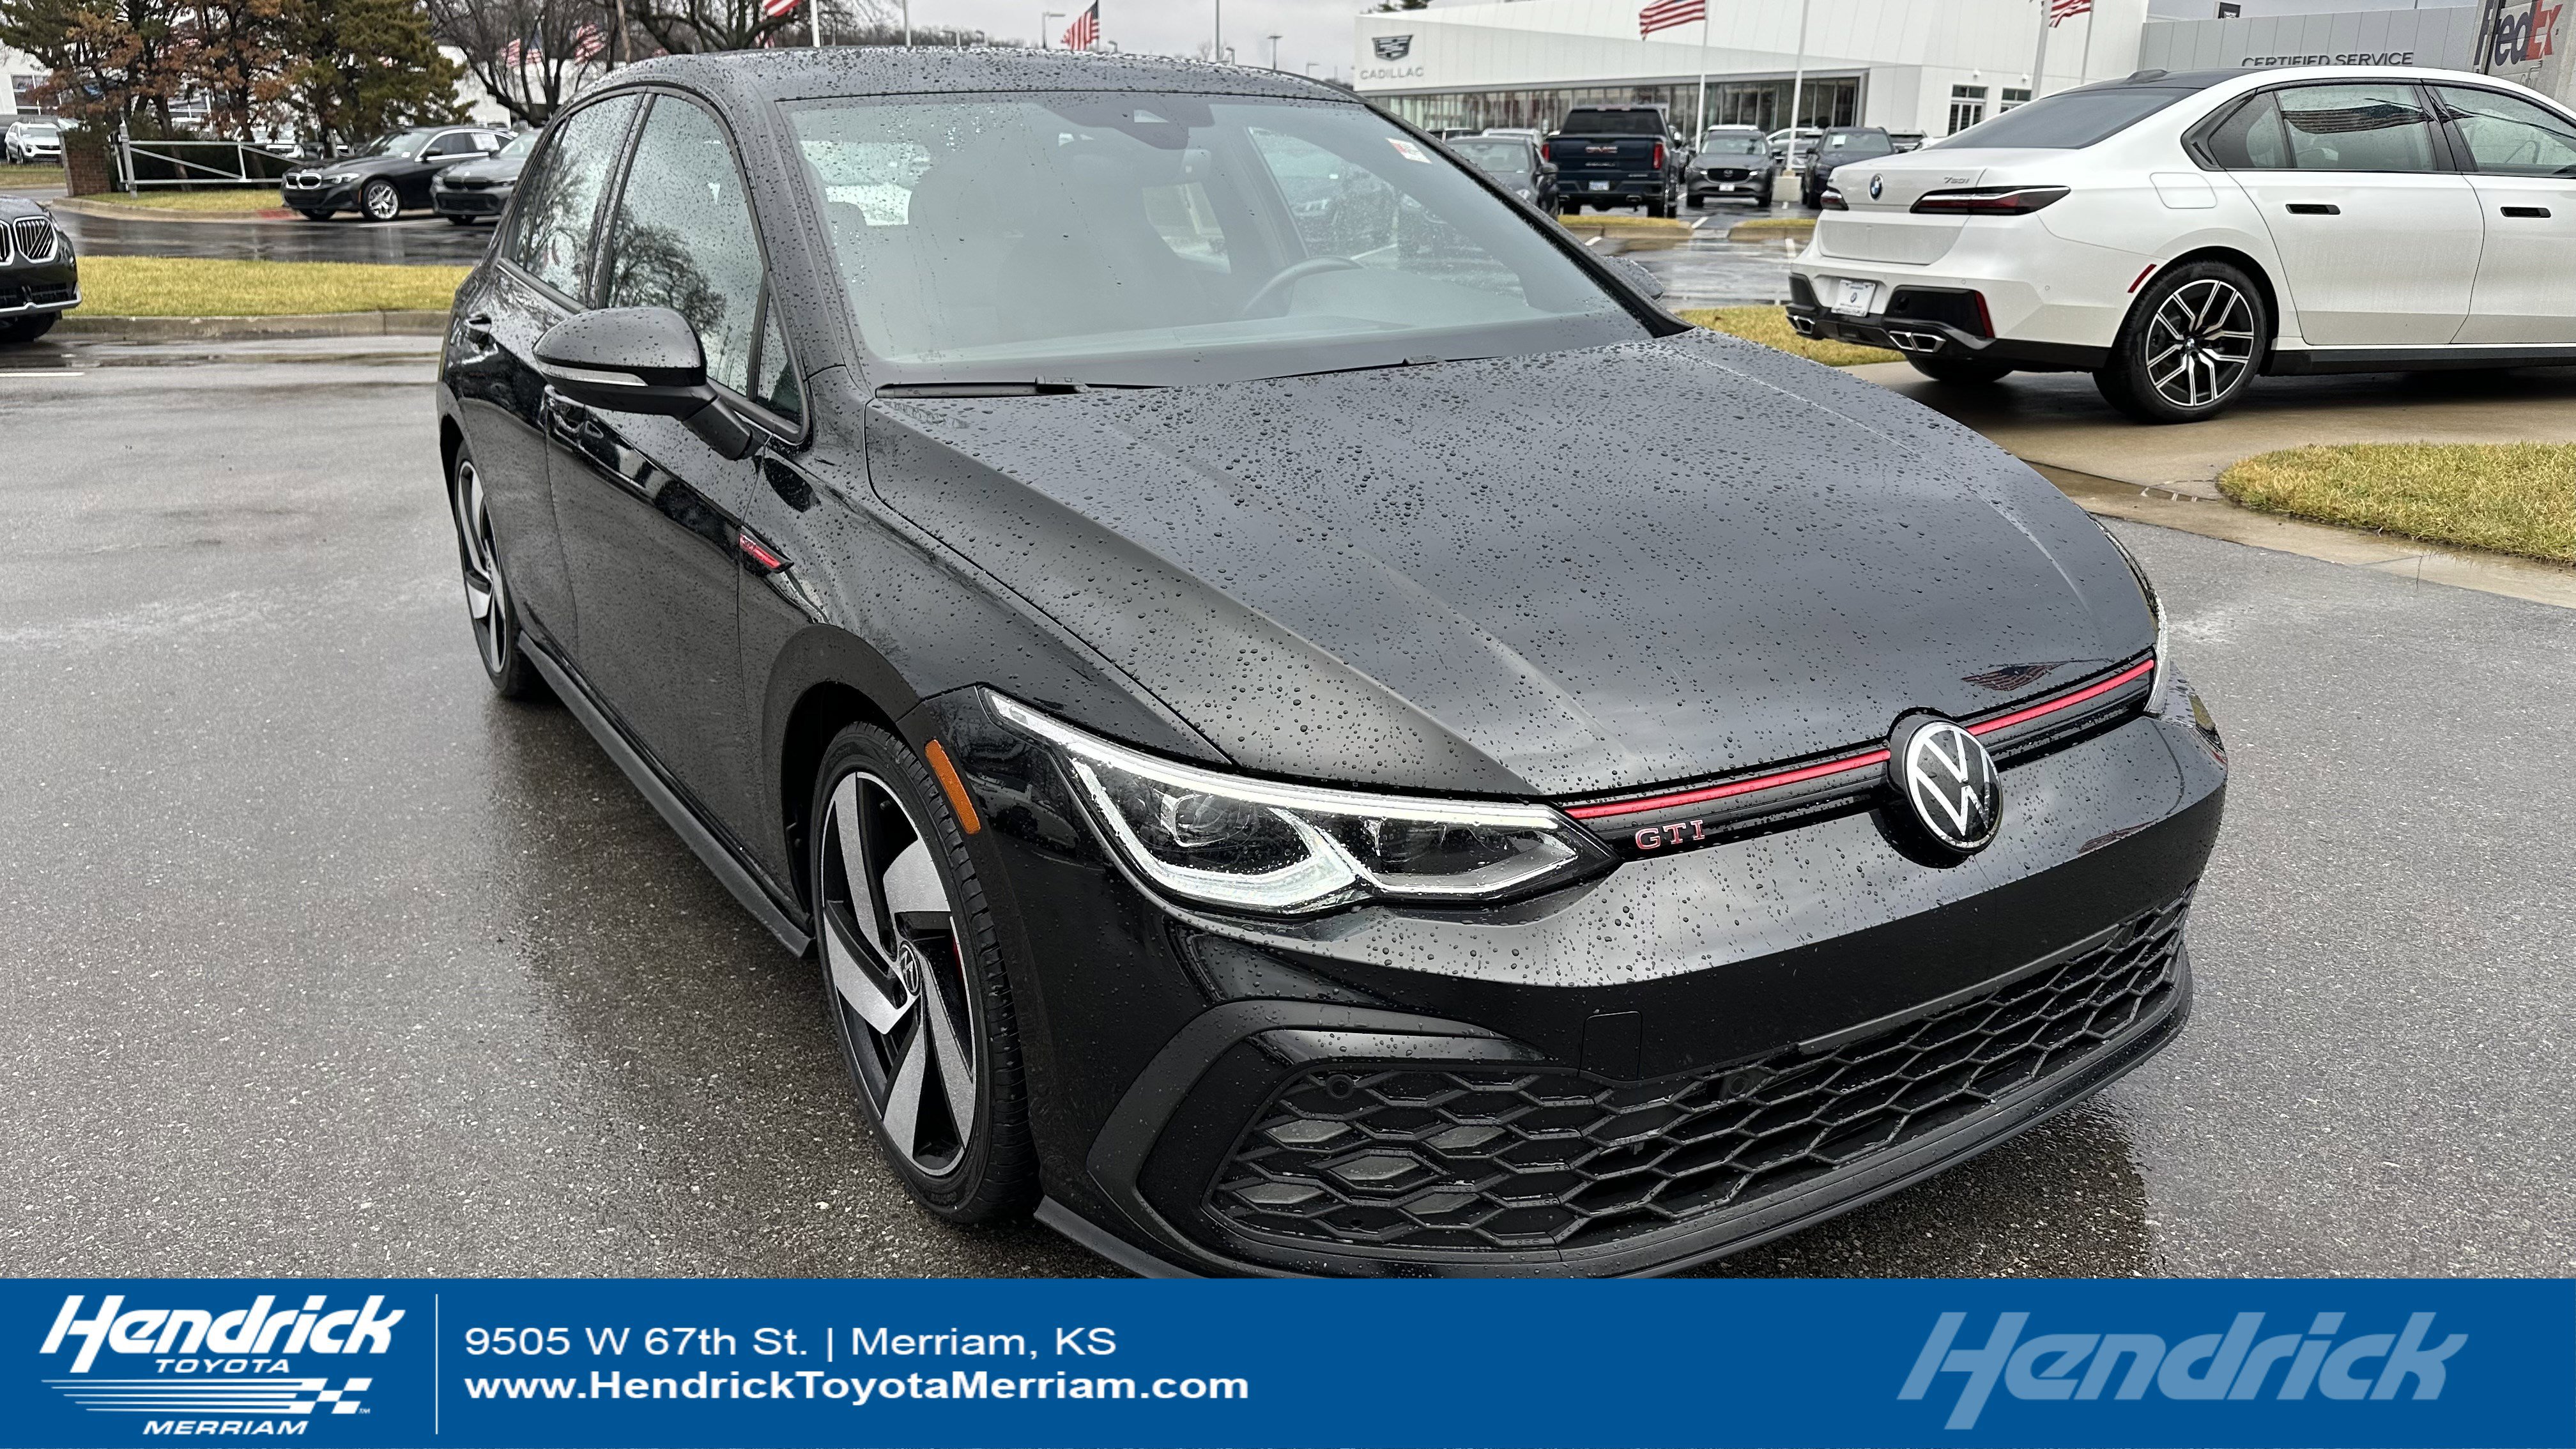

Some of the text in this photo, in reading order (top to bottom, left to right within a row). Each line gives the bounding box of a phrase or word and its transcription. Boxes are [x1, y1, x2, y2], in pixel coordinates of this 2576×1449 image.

[2334, 52, 2414, 66] SERVICE
[1360, 66, 1424, 79] CADILLAC
[1635, 819, 1705, 850] GTI
